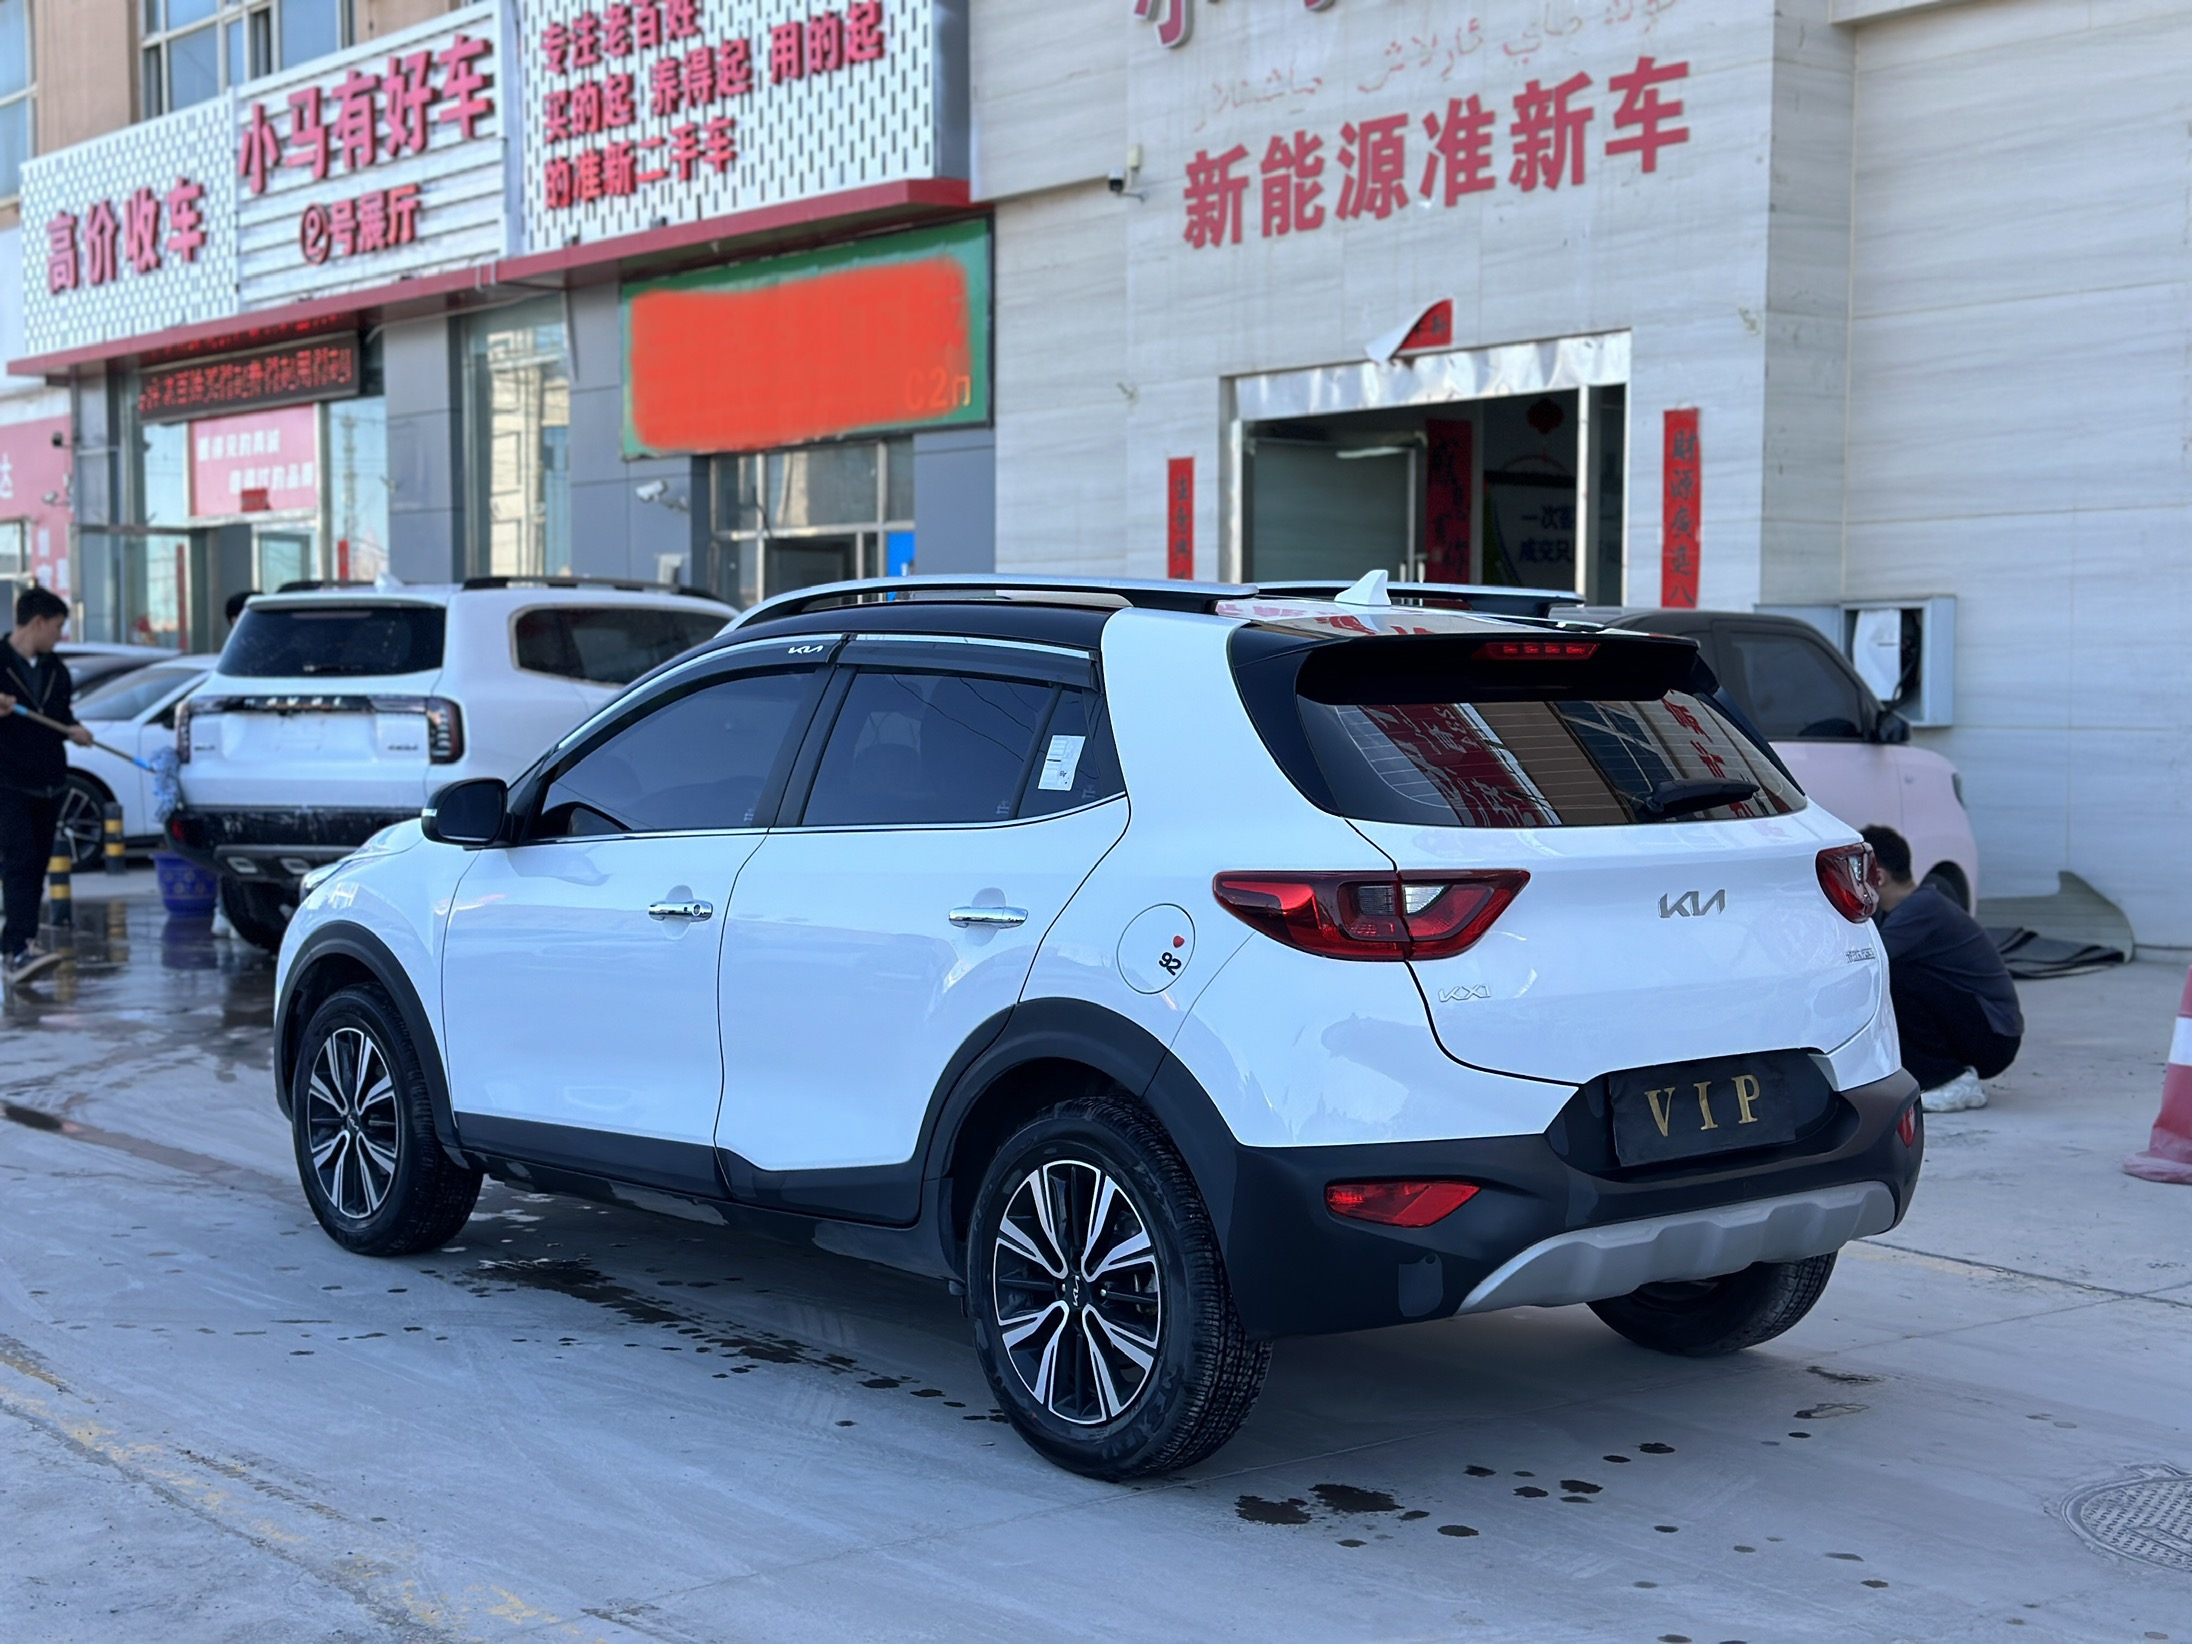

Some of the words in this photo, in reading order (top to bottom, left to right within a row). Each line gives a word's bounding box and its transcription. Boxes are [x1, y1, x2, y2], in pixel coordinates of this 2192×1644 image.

[541, 0, 702, 75] 专注老百姓
[544, 74, 634, 146] 买的起
[651, 38, 752, 116] 养得起
[770, 1, 885, 84] 用的起
[238, 34, 493, 195] 小马有好车
[1182, 55, 1690, 250] 新能源准新车
[544, 117, 736, 209] 的准新二手车
[46, 176, 206, 294] 高价收车
[1658, 889, 1726, 919] KIA
[1159, 952, 1181, 976] 92
[1438, 984, 1491, 1002] KX1
[1644, 1074, 1760, 1137] VIP
